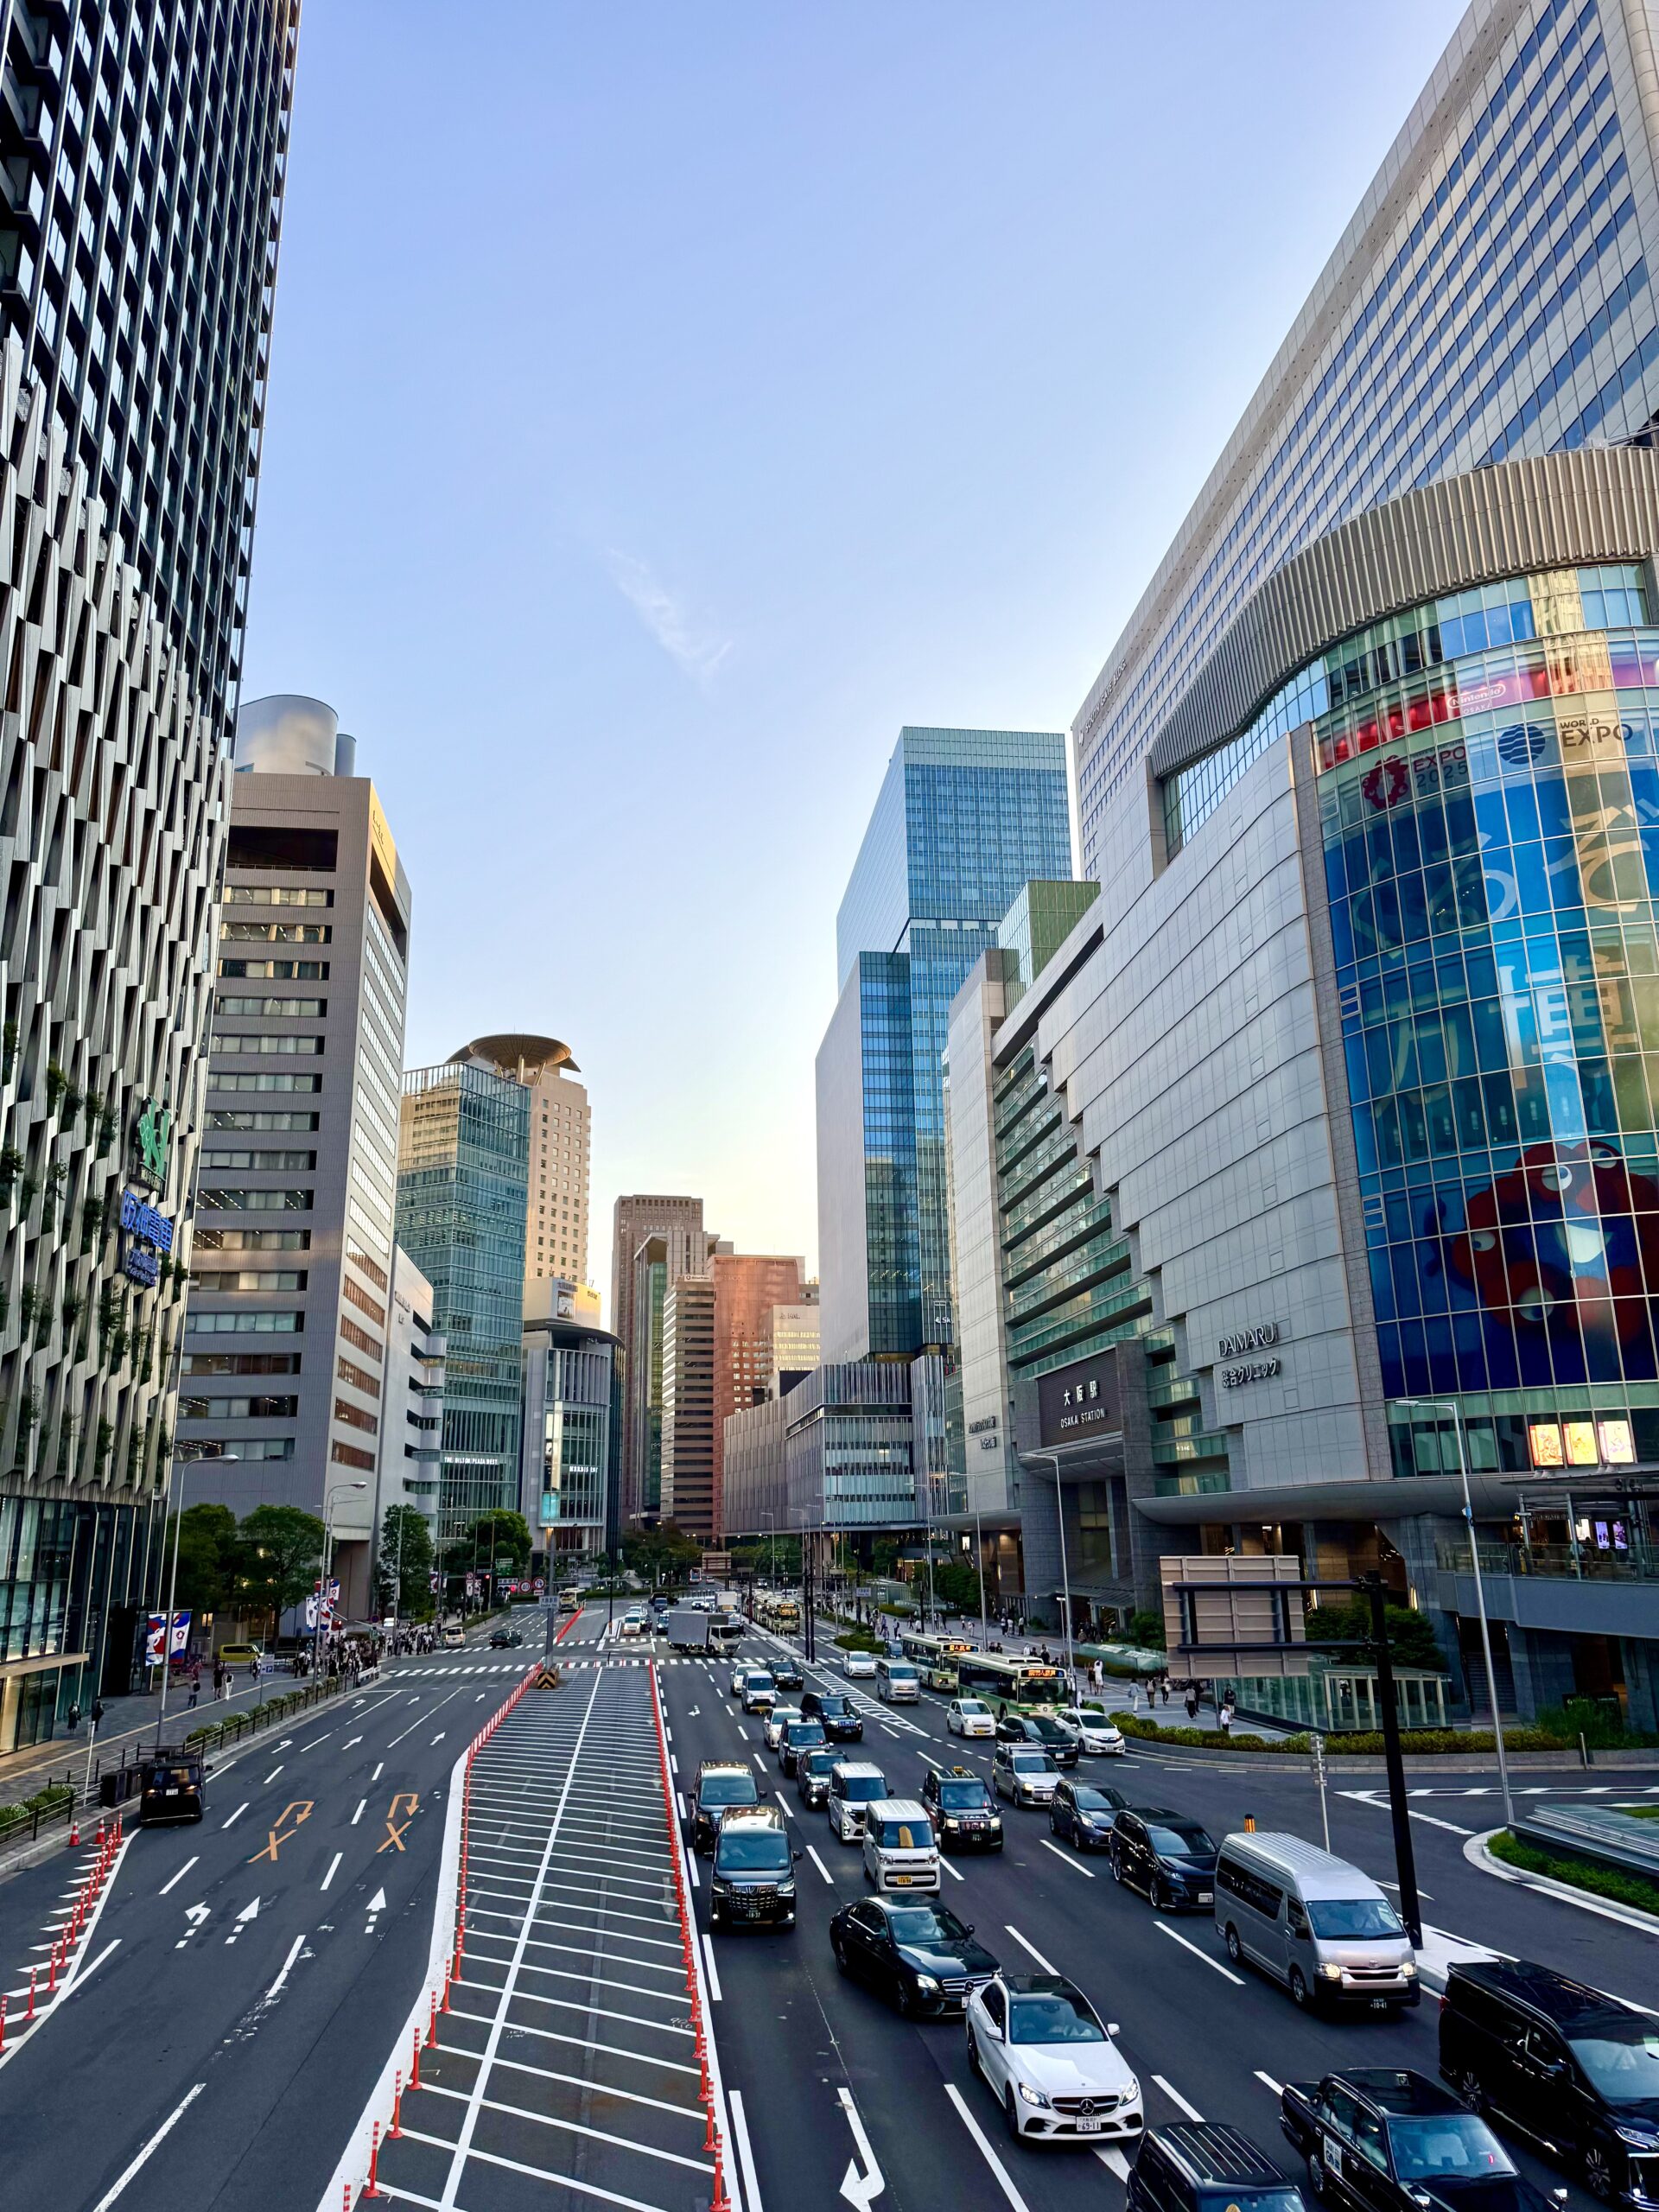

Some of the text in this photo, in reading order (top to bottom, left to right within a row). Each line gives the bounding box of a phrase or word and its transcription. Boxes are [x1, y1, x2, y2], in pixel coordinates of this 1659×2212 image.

[1452, 687, 1502, 706] Nintendo
[1560, 723, 1634, 747] EXPO
[1413, 746, 1466, 773] EXPO
[1415, 760, 1468, 789] 2025
[1218, 1324, 1275, 1357] DAIMARU
[1064, 1380, 1097, 1407] 大阪駅
[1060, 1408, 1105, 1428] OSAKA STATION
